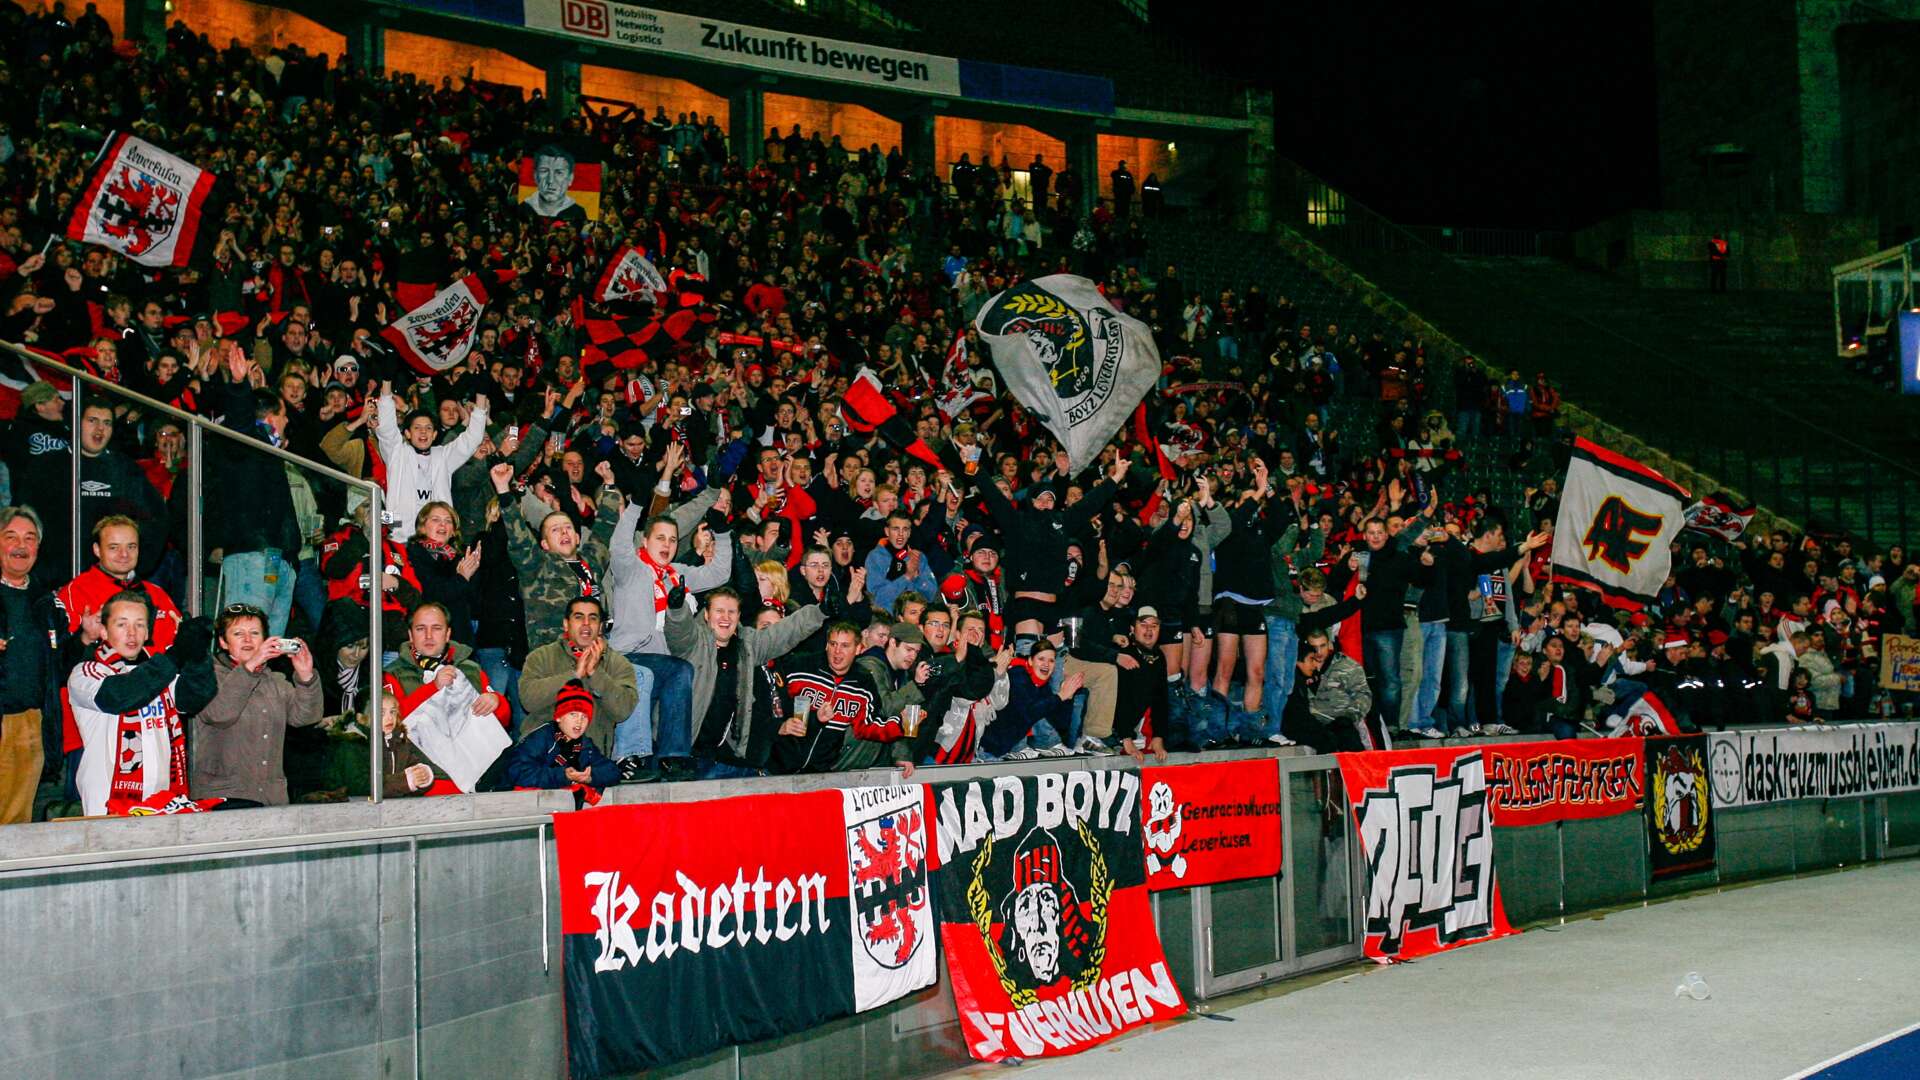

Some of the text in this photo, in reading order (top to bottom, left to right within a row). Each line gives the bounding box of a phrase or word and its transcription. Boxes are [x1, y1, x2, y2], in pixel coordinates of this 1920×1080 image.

[567, 2, 604, 30] DB
[614, 7, 658, 22] Mobility
[615, 19, 665, 33] Networks
[616, 31, 663, 45] Logistics
[701, 23, 930, 82] Zukunft bewegen
[1068, 398, 1098, 425] BOYZ
[1745, 728, 1920, 800] daskreuzmussbleiben.d
[1036, 770, 1140, 836] BOYZ
[584, 866, 831, 974] Kadetten
